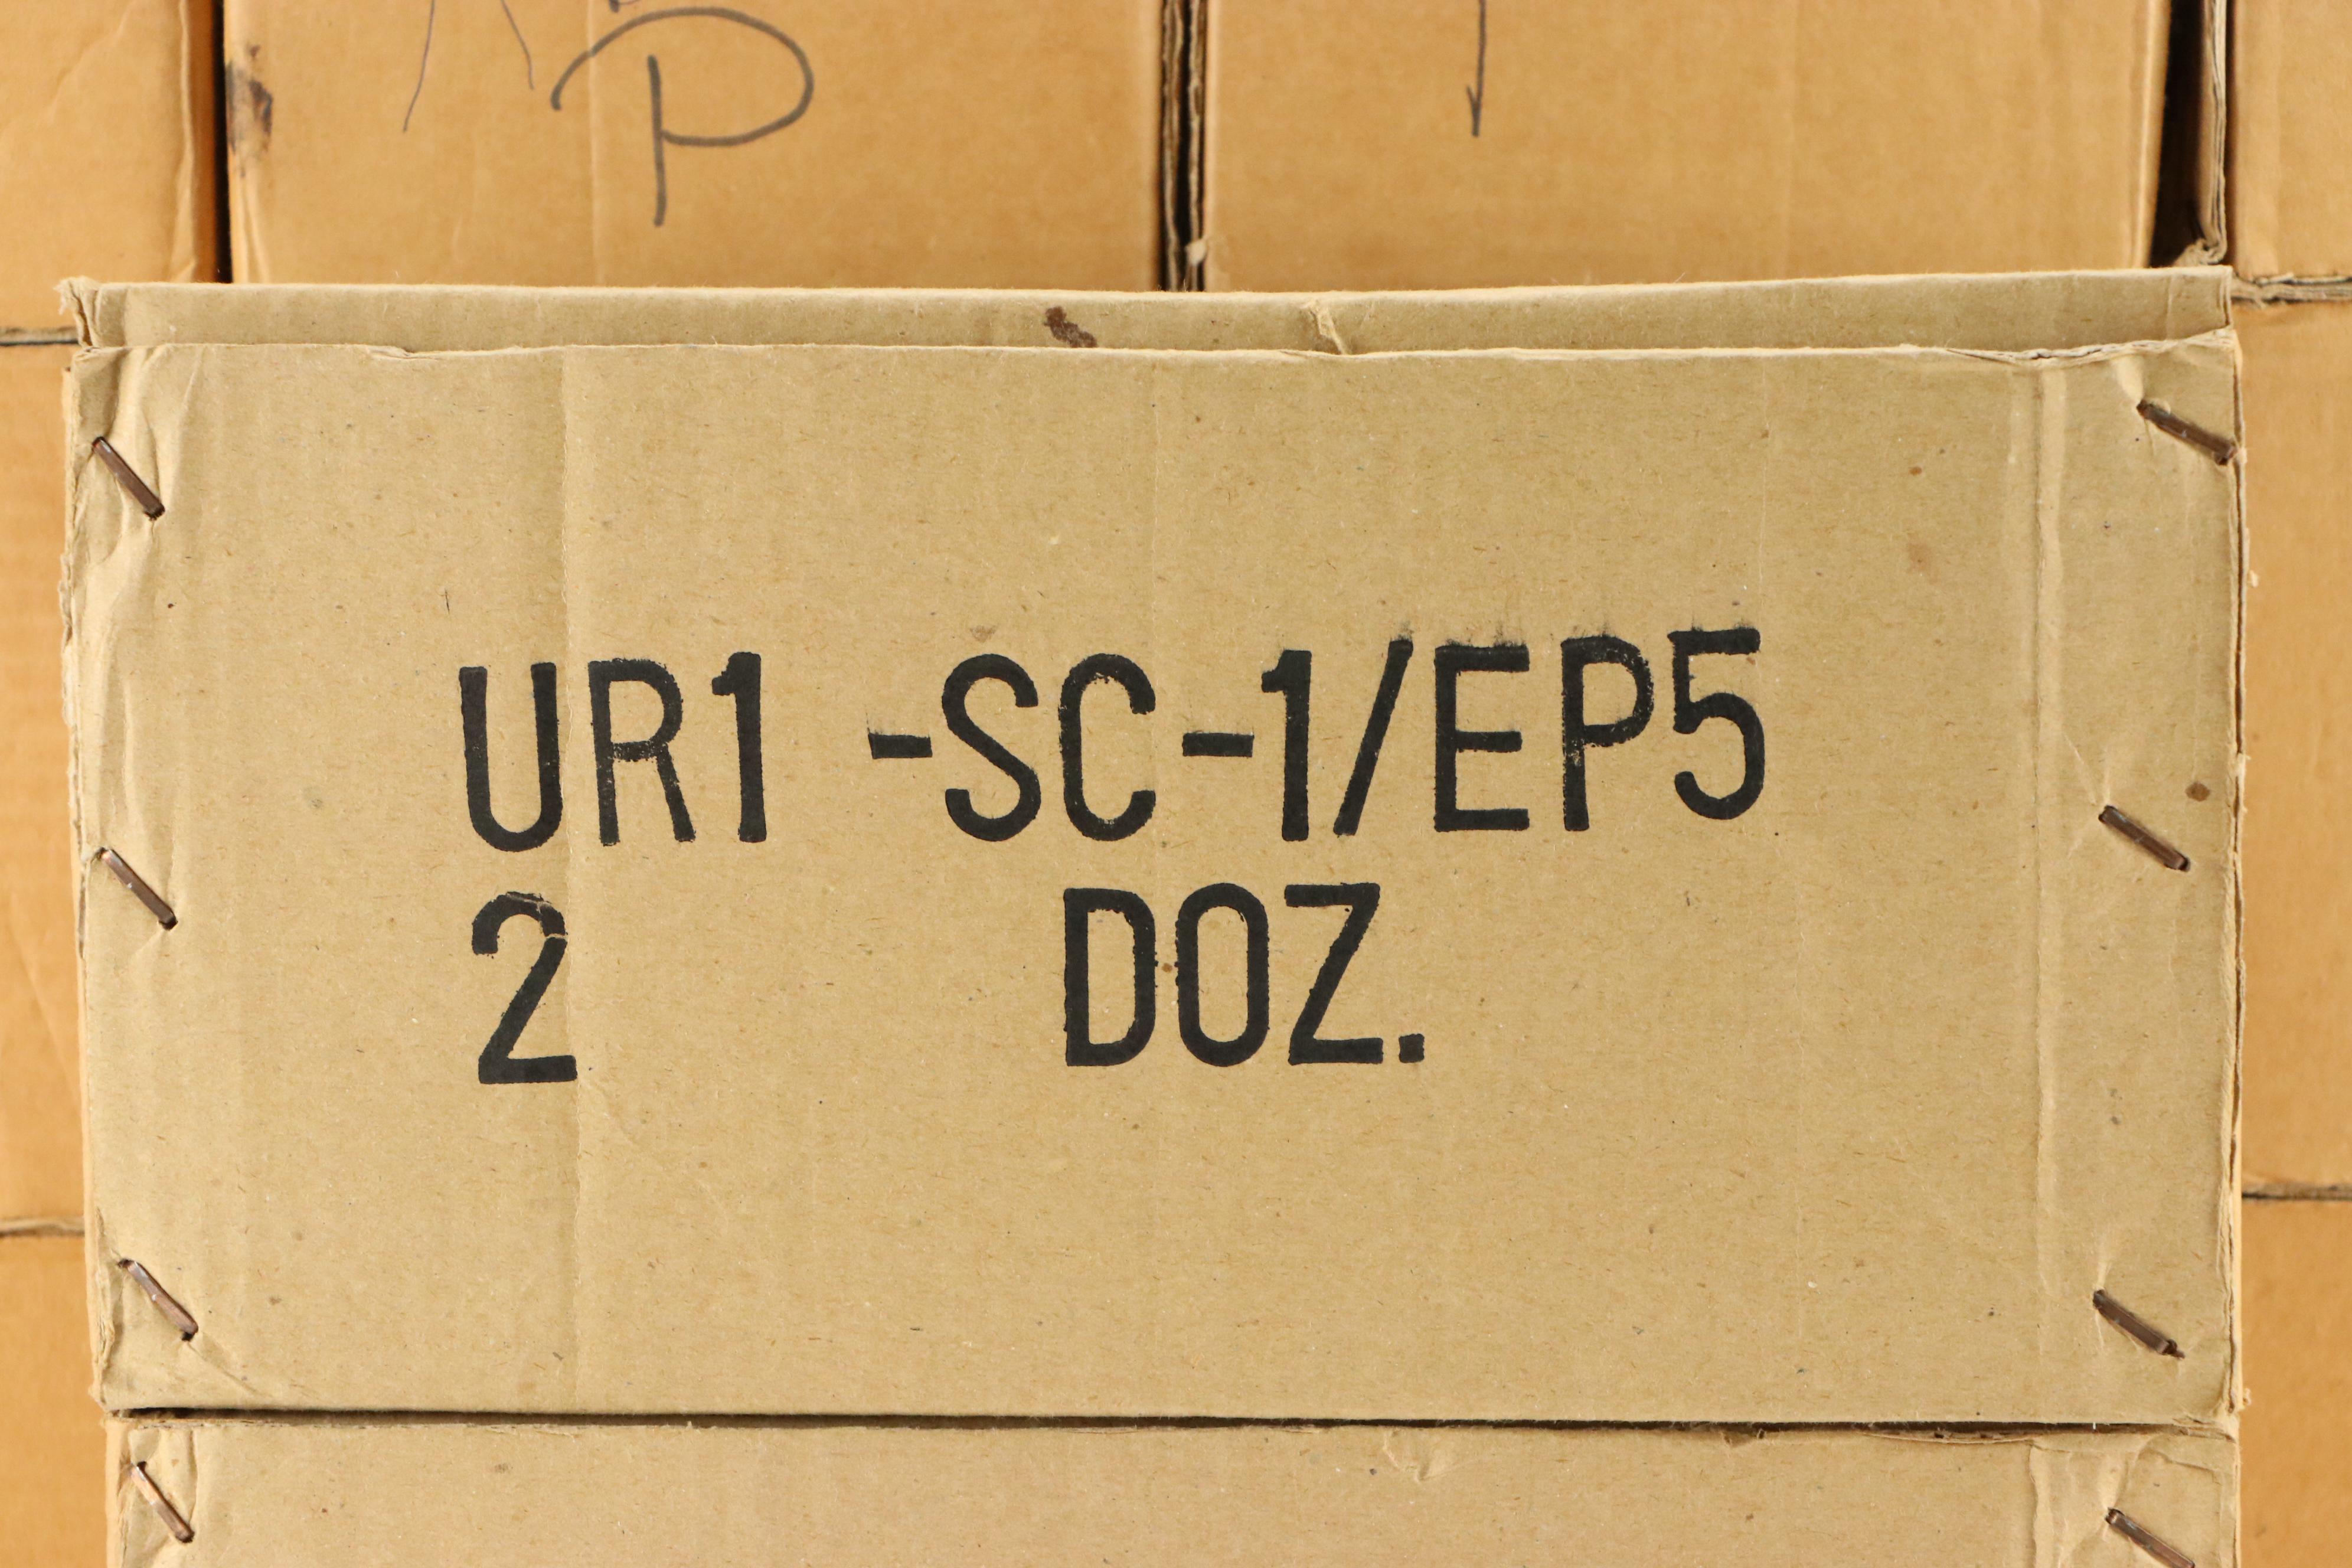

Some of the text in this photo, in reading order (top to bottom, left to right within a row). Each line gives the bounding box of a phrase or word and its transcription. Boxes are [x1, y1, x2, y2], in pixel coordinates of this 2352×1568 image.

[459, 651, 767, 852] UR1
[471, 883, 1425, 1084] 2 DOZ.
